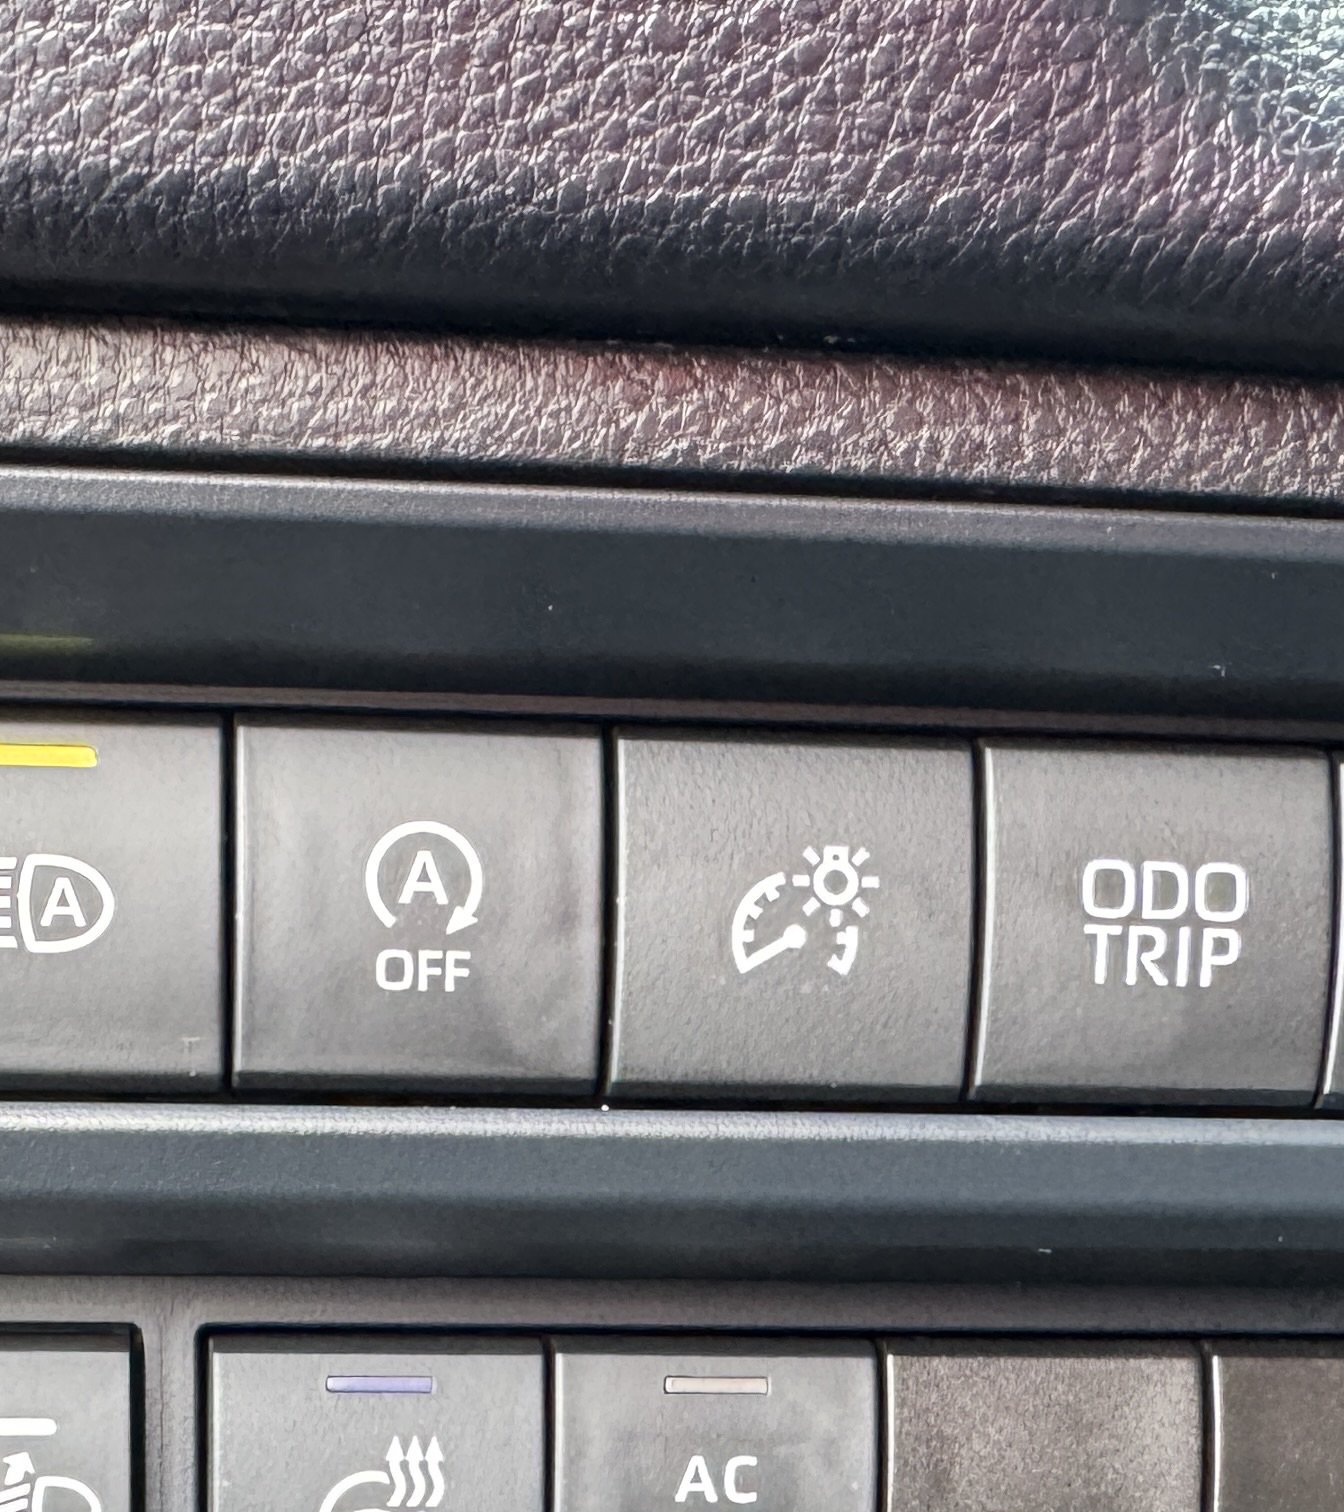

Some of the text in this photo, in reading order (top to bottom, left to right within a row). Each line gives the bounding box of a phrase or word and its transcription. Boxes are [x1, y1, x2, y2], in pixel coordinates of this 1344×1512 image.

[39, 877, 87, 927] A
[397, 850, 449, 905] A
[1080, 858, 1249, 921] ODO
[375, 949, 471, 992] OFF
[1084, 925, 1241, 988] TRIP
[674, 1456, 759, 1504] AC
